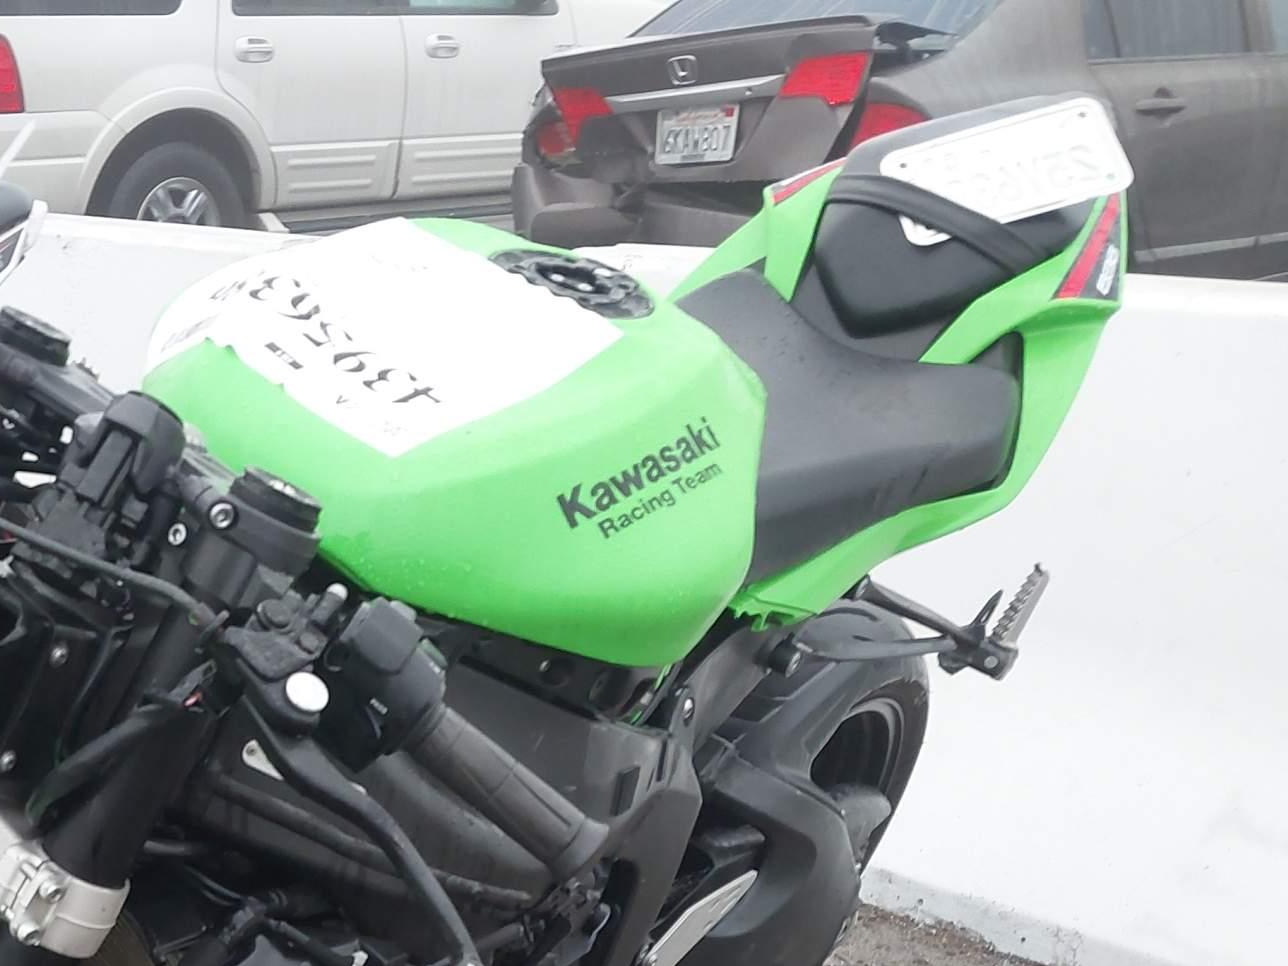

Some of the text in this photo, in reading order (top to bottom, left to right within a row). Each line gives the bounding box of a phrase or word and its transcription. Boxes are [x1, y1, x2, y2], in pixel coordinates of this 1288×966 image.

[556, 416, 720, 529] Kawasaki
[597, 463, 723, 539] Racing Team
